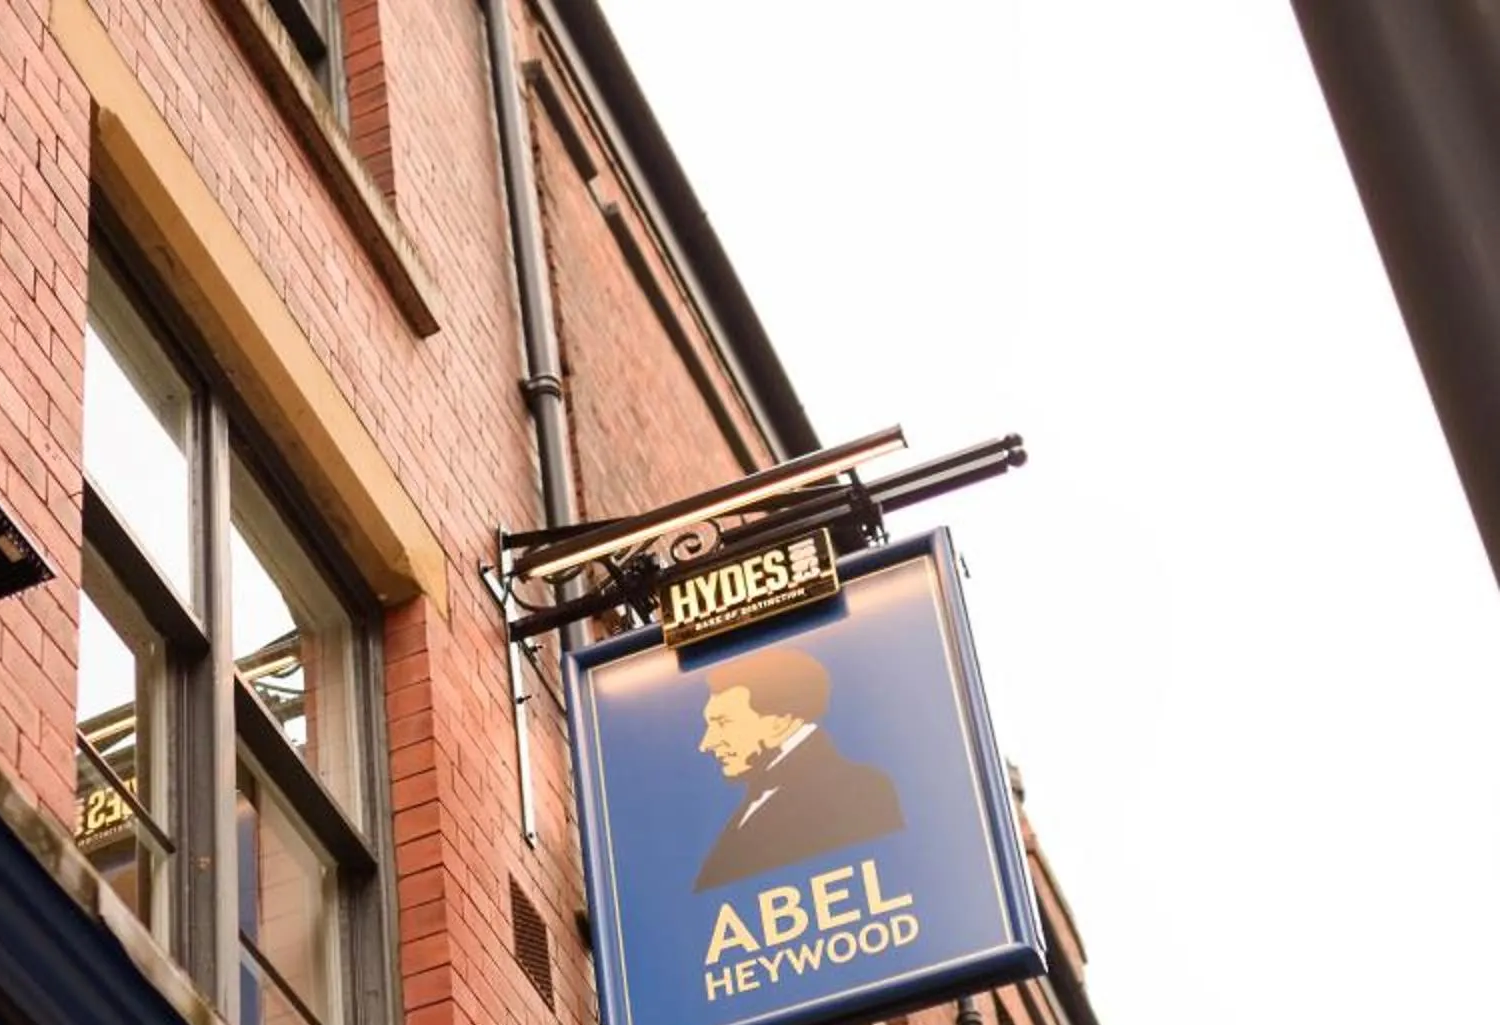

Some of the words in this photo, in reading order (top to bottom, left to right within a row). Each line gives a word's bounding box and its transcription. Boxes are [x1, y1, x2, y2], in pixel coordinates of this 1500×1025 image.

[669, 549, 789, 625] HYDES
[705, 859, 913, 966] ABEL
[705, 914, 919, 1001] HEYWOOD
